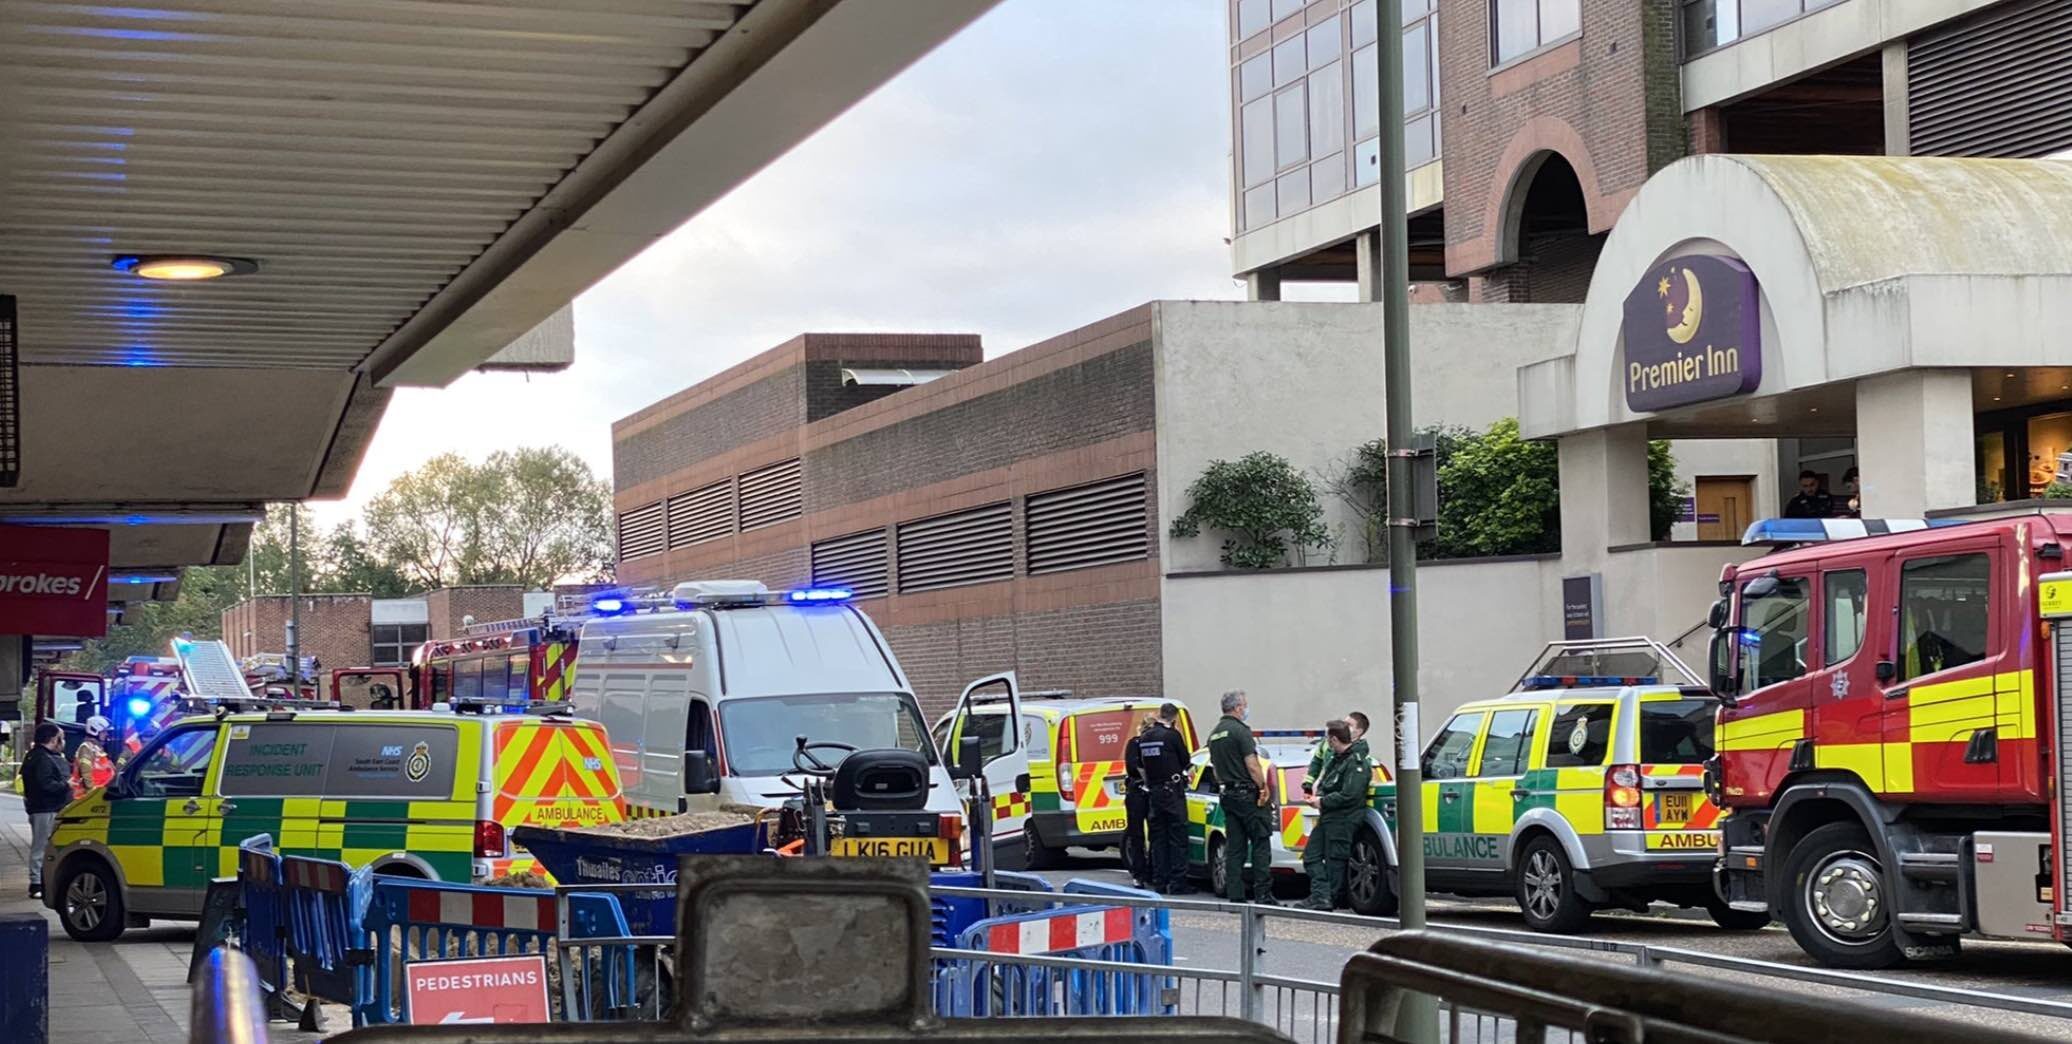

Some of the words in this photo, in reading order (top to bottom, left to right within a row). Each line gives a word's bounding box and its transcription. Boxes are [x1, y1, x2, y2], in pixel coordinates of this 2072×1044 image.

[1630, 352, 1704, 393] Premier
[1707, 344, 1738, 377] Inn
[1099, 734, 1118, 744] 999
[249, 743, 307, 756] INCIDENT
[381, 745, 403, 756] NHS
[224, 763, 292, 777] RESPONSE
[294, 763, 323, 777] UNIT
[584, 757, 602, 770] NHS
[1666, 795, 1687, 808] EU11
[537, 806, 604, 820] AMBULANCE
[1090, 818, 1126, 832] AMB
[1660, 833, 1719, 848] AMBU
[416, 971, 538, 992] PEDESTRIANS
